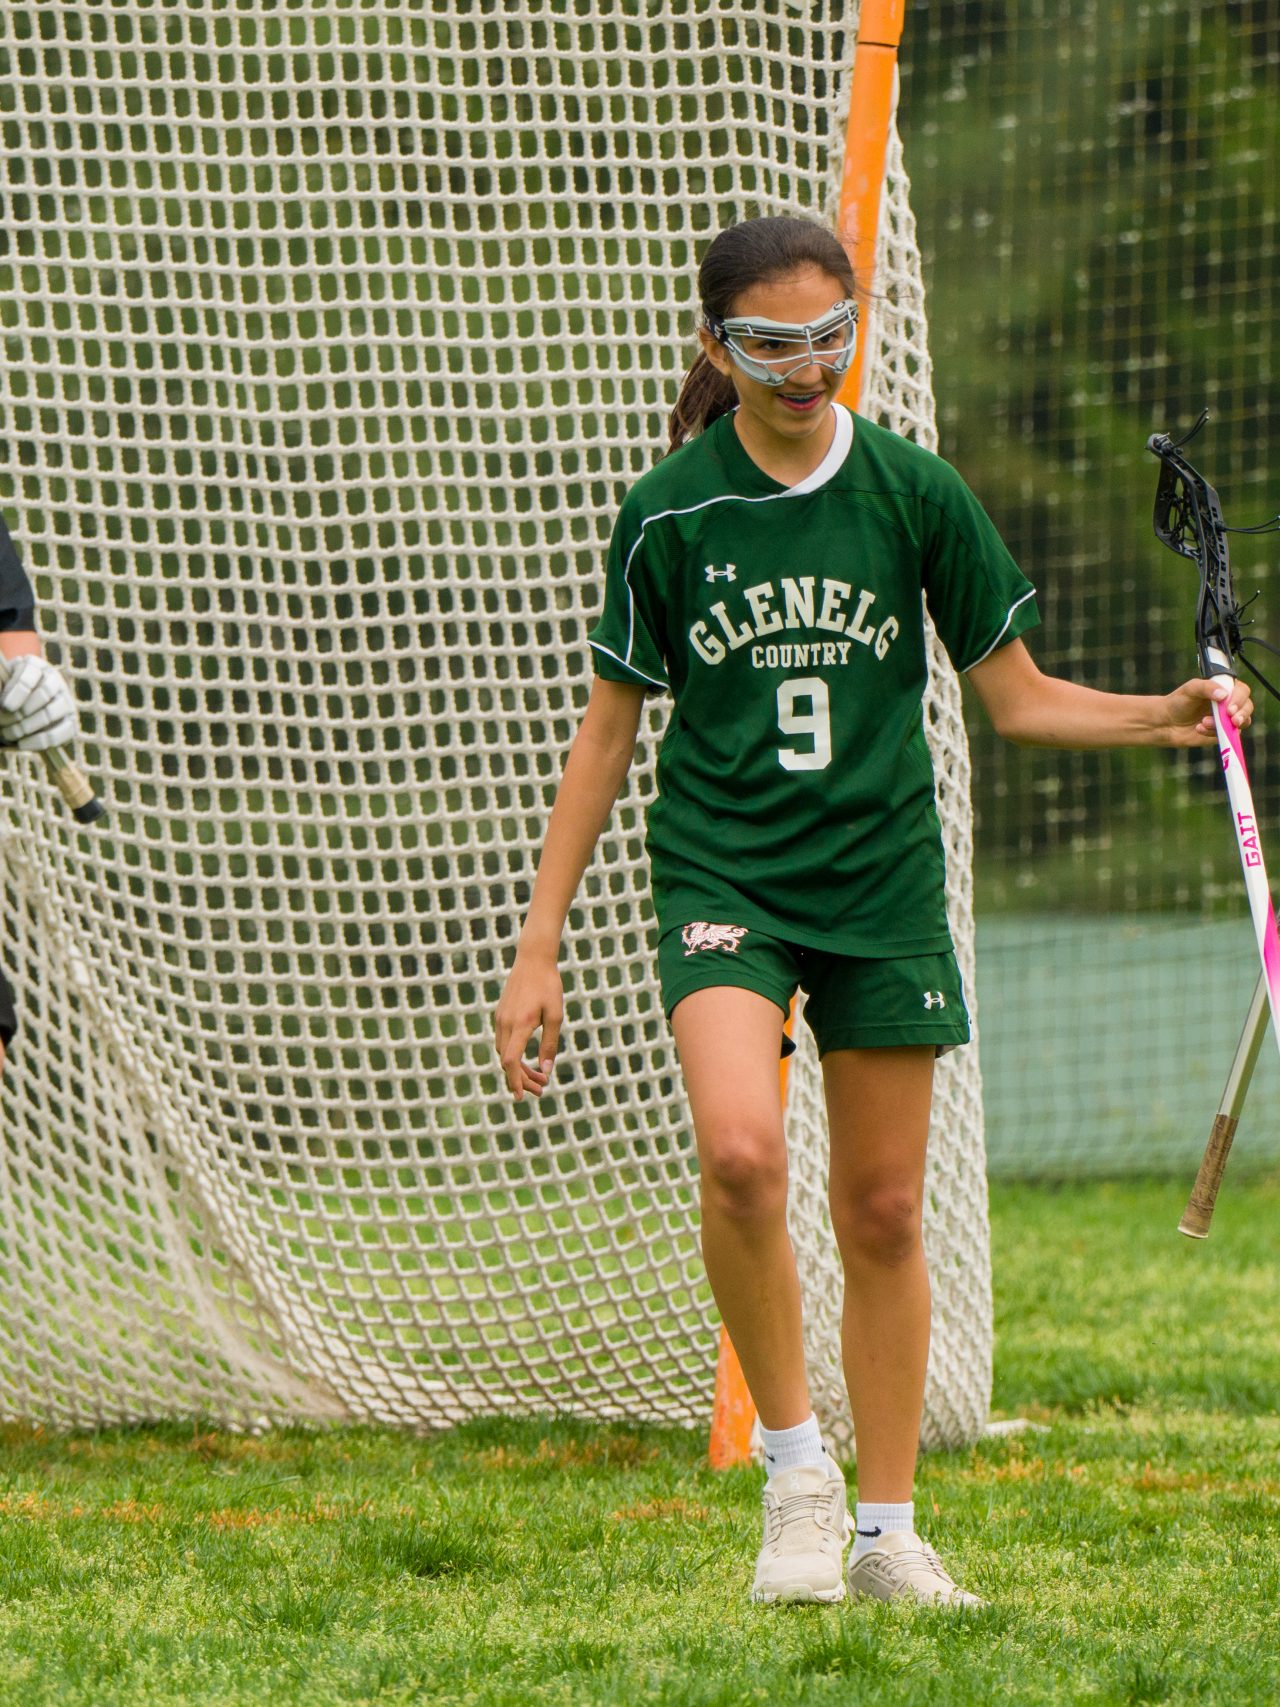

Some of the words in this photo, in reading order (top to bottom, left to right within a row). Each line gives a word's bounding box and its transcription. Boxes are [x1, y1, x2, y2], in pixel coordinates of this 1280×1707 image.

[689, 576, 899, 665] GLENELG
[751, 642, 851, 668] COUNTRY
[776, 676, 832, 770] 9
[1237, 811, 1261, 867] GAIT
